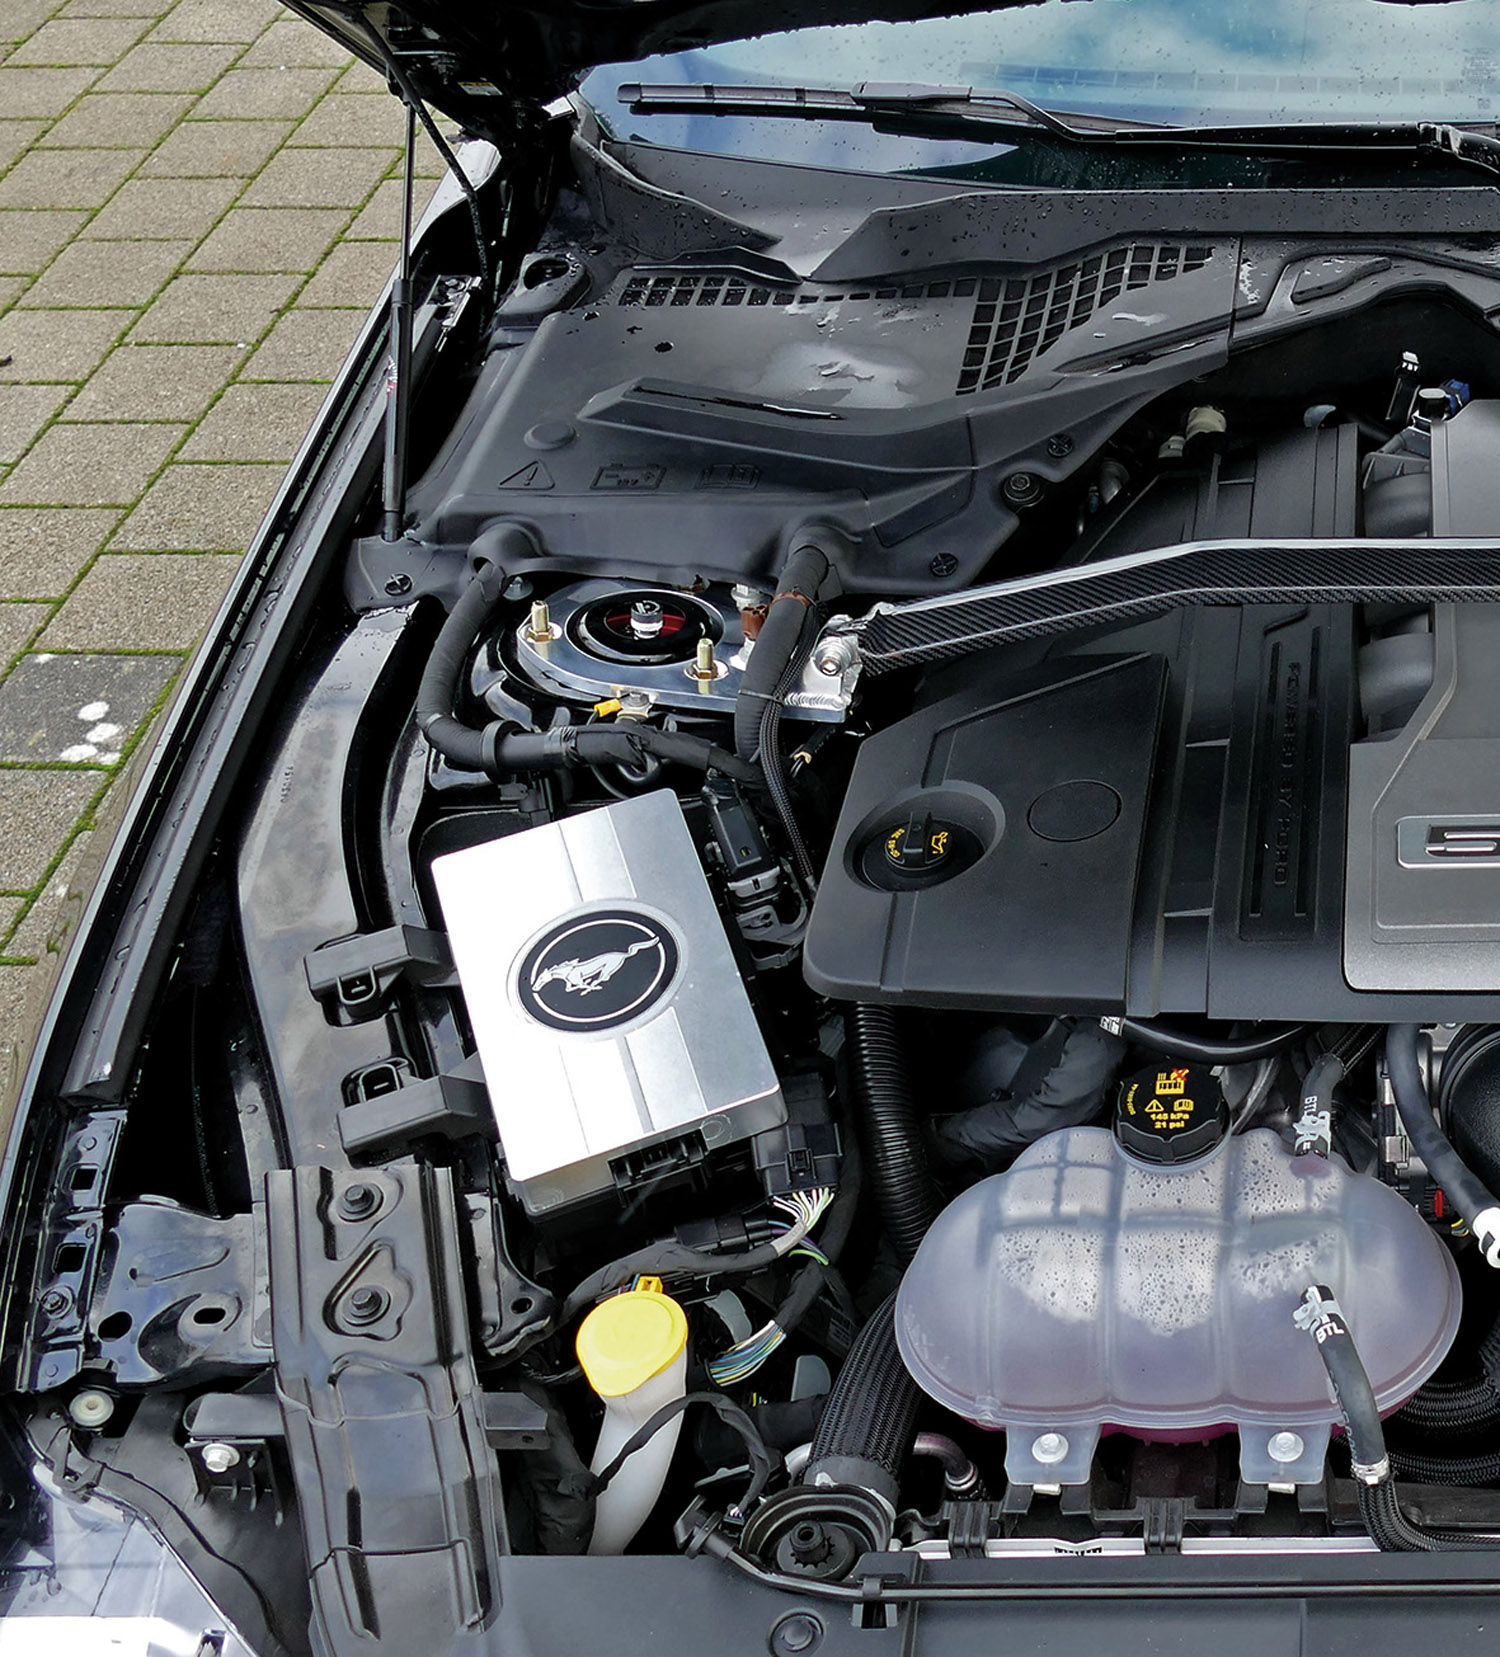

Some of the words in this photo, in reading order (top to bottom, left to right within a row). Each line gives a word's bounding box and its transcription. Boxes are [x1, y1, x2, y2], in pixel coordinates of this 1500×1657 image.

[1150, 1113, 1169, 1121] 145
[1170, 1112, 1190, 1120] kPa
[1154, 1121, 1167, 1129] 21
[1169, 1120, 1185, 1129] psi
